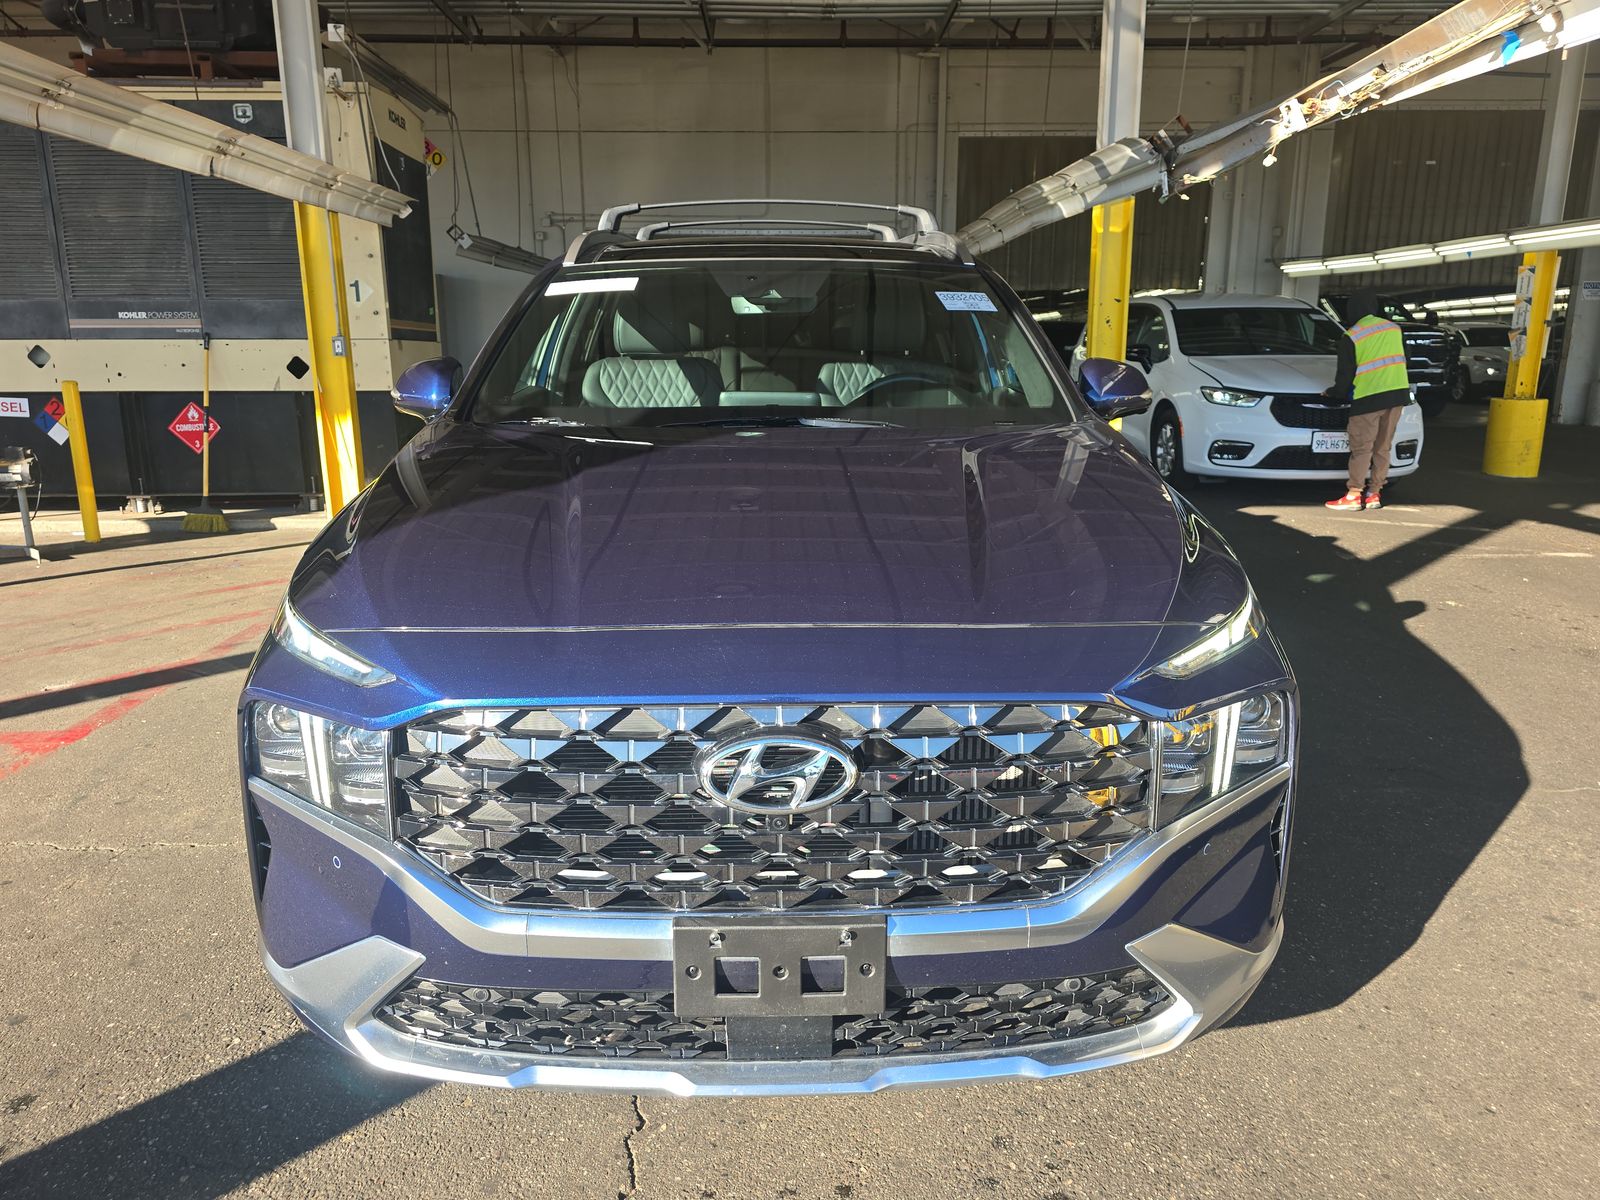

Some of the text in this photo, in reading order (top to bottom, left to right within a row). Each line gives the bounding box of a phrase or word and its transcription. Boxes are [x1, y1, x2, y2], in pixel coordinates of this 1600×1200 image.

[349, 279, 361, 302] 1
[118, 311, 147, 319] KOHLER
[147, 311, 173, 319] POWER
[0, 401, 28, 413] SEL
[50, 400, 62, 416] 2
[40, 414, 49, 430] 1
[175, 423, 215, 432] COMBUSTIE
[194, 440, 201, 448] 3
[1315, 439, 1350, 450] 9PLH679
